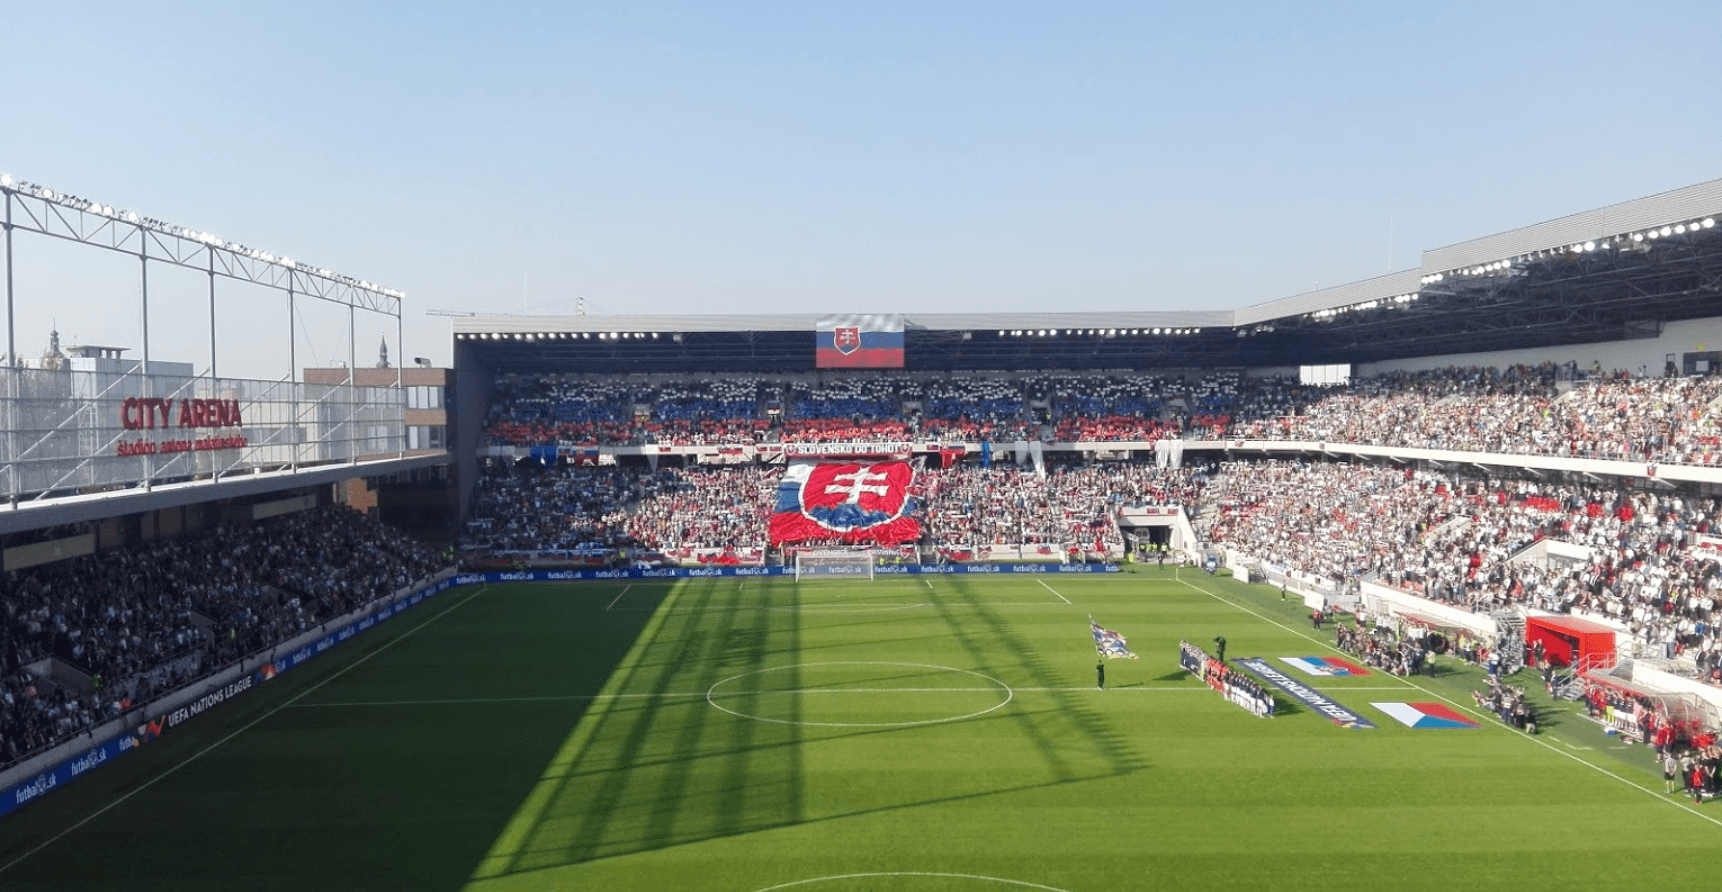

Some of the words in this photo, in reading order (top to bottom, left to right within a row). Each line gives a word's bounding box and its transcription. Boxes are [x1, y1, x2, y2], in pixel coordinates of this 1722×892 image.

[121, 397, 172, 430] CITY
[178, 398, 242, 428] ARENA
[797, 444, 852, 454] SLOVENSKO
[854, 444, 868, 453] DO
[870, 444, 898, 453] TOHO!
[168, 707, 189, 727] UEFA
[190, 689, 224, 717] NATIONS
[224, 676, 252, 699] LEAGUE
